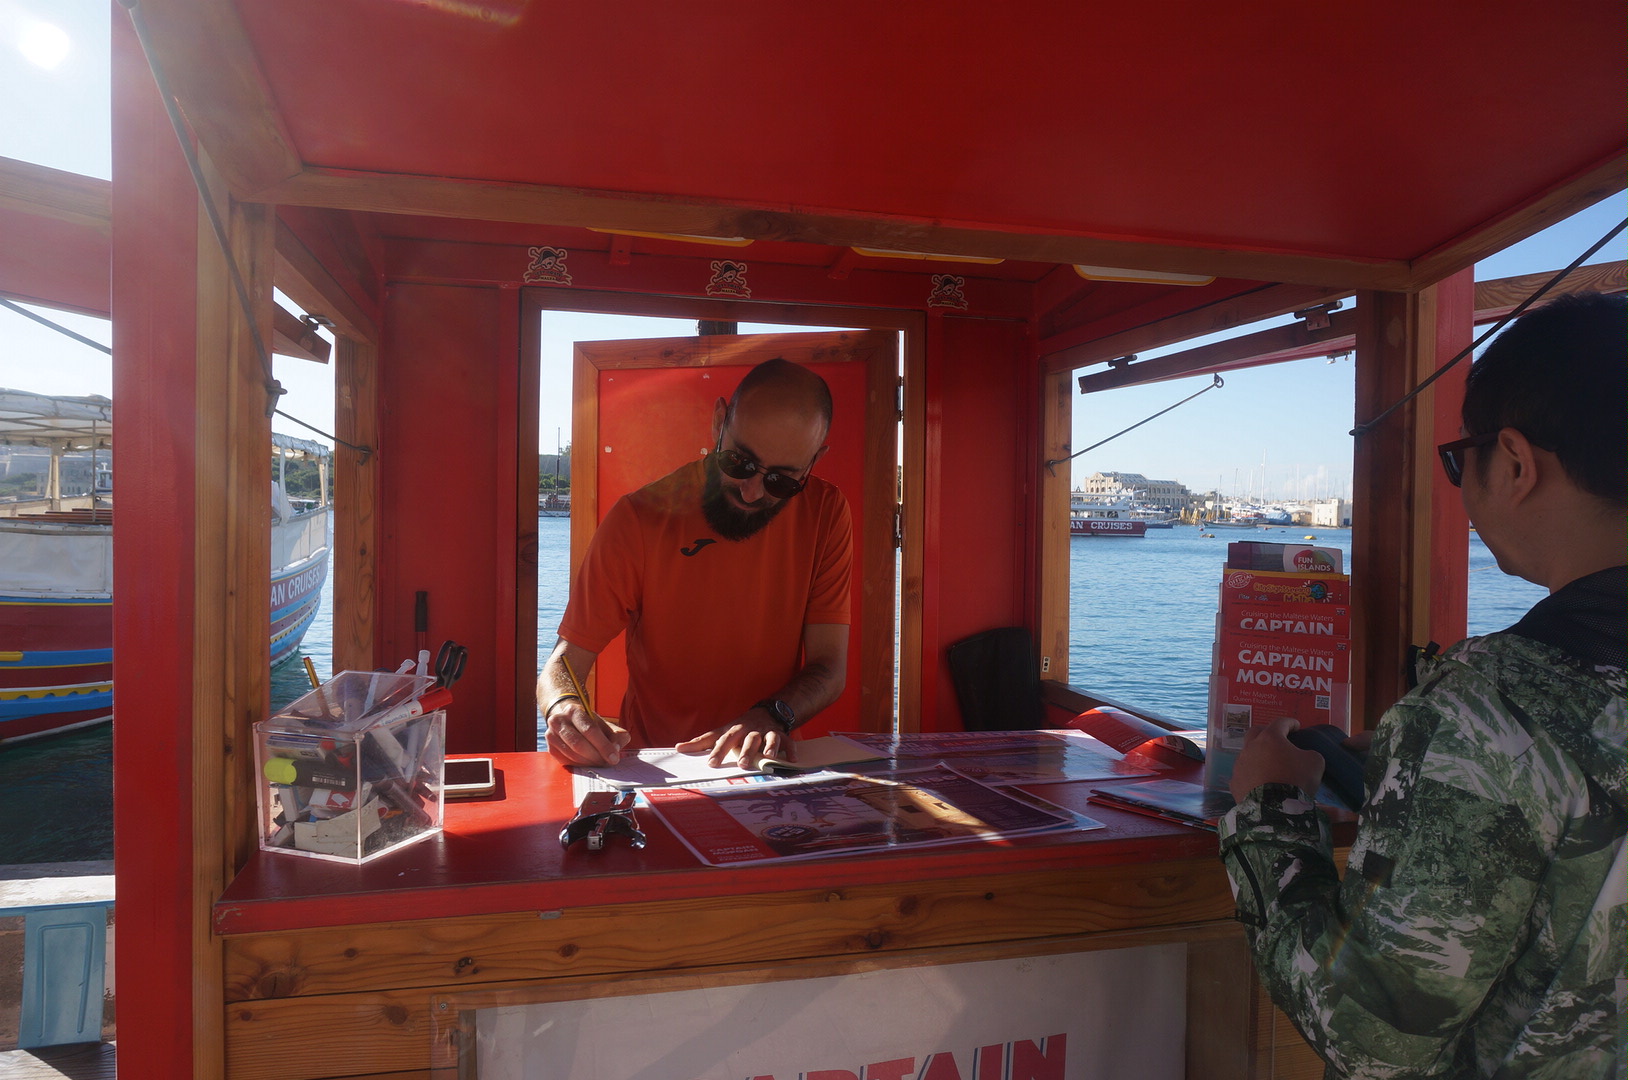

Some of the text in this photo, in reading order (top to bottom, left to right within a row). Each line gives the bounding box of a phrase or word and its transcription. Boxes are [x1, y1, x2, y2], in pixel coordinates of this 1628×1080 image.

[1090, 521, 1133, 530] CRUISES
[1298, 556, 1313, 564] FUN
[1297, 563, 1331, 572] ISLANDS
[288, 564, 320, 599] CRUISES
[1241, 610, 1268, 619] Cruising
[1310, 614, 1334, 622] Waters
[1240, 618, 1334, 636] CAPTAIN
[1240, 641, 1267, 651] Cruising
[1282, 645, 1309, 654] Maltese
[1310, 647, 1334, 656] Waters
[1238, 649, 1334, 673] CAPTAIN
[1236, 668, 1333, 692] MORGAN
[1233, 696, 1253, 704] Queen
[1252, 690, 1277, 699] Majesty
